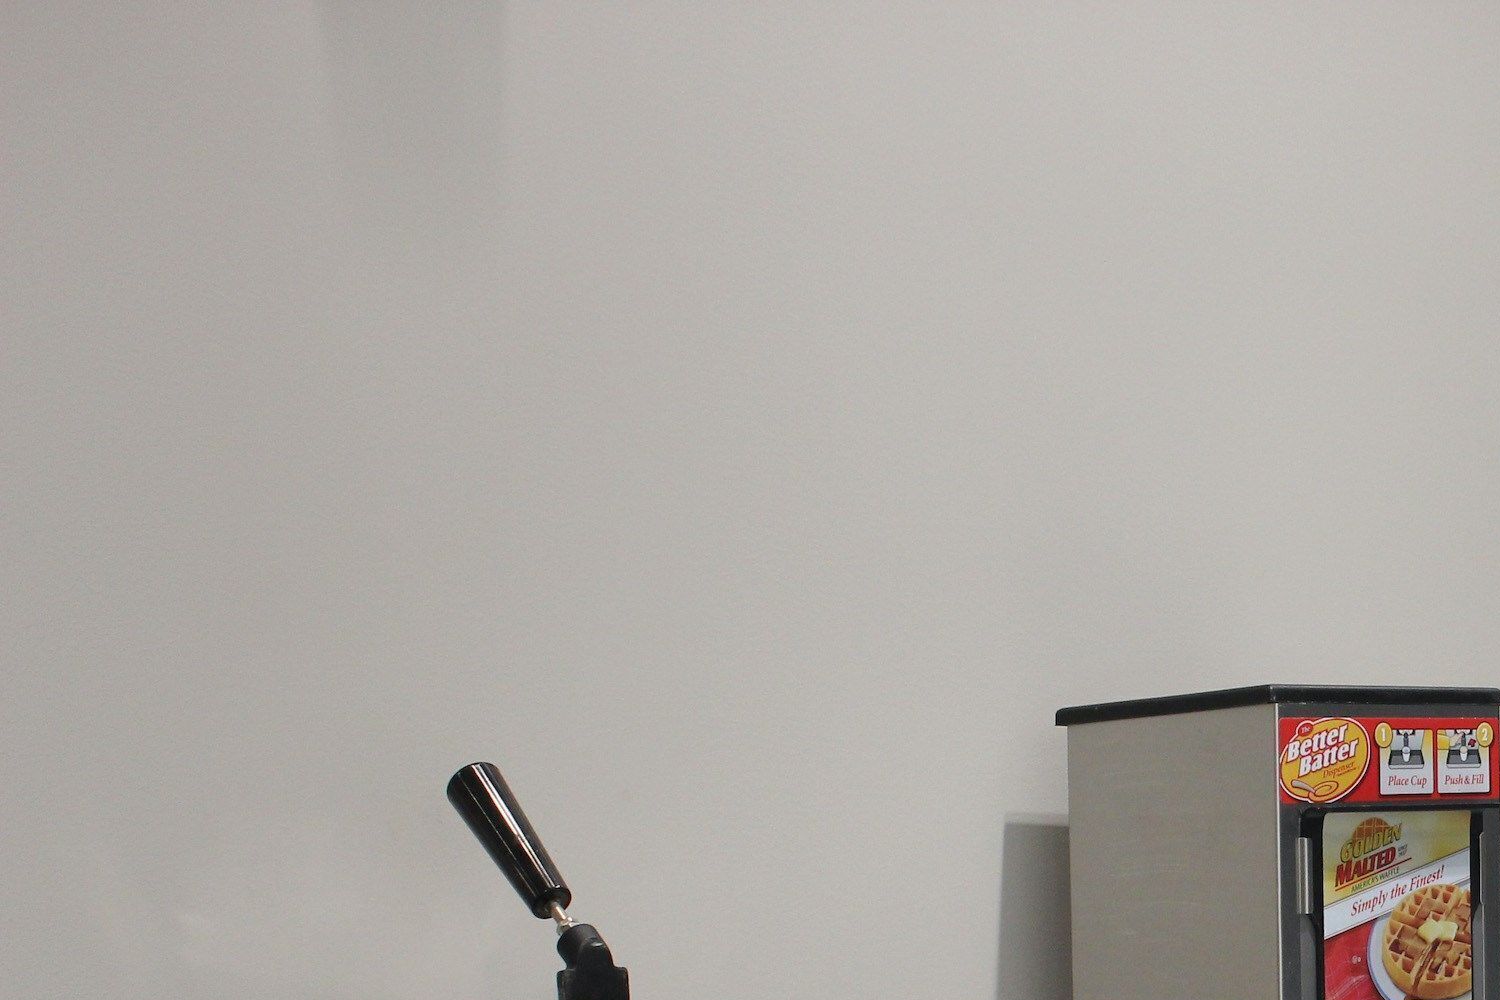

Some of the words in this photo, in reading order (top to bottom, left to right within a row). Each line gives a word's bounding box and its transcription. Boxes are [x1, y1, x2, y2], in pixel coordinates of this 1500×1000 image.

[1286, 722, 1349, 764] Better
[1381, 727, 1387, 742] 1
[1482, 727, 1490, 742] 2
[1298, 737, 1360, 779] Batter
[1388, 775, 1410, 787] Place
[1411, 775, 1427, 789] Cup
[1444, 774, 1464, 786] Push
[1464, 776, 1471, 785] &
[1472, 774, 1485, 785] Fill
[1340, 823, 1402, 864] GOLDEN
[1335, 846, 1397, 888] MALTED
[1351, 875, 1380, 893] AMERICA'S
[1379, 866, 1400, 882] WAFFLE
[1350, 889, 1389, 917] Simply
[1390, 882, 1408, 900] the
[1409, 864, 1445, 892] Finest!
